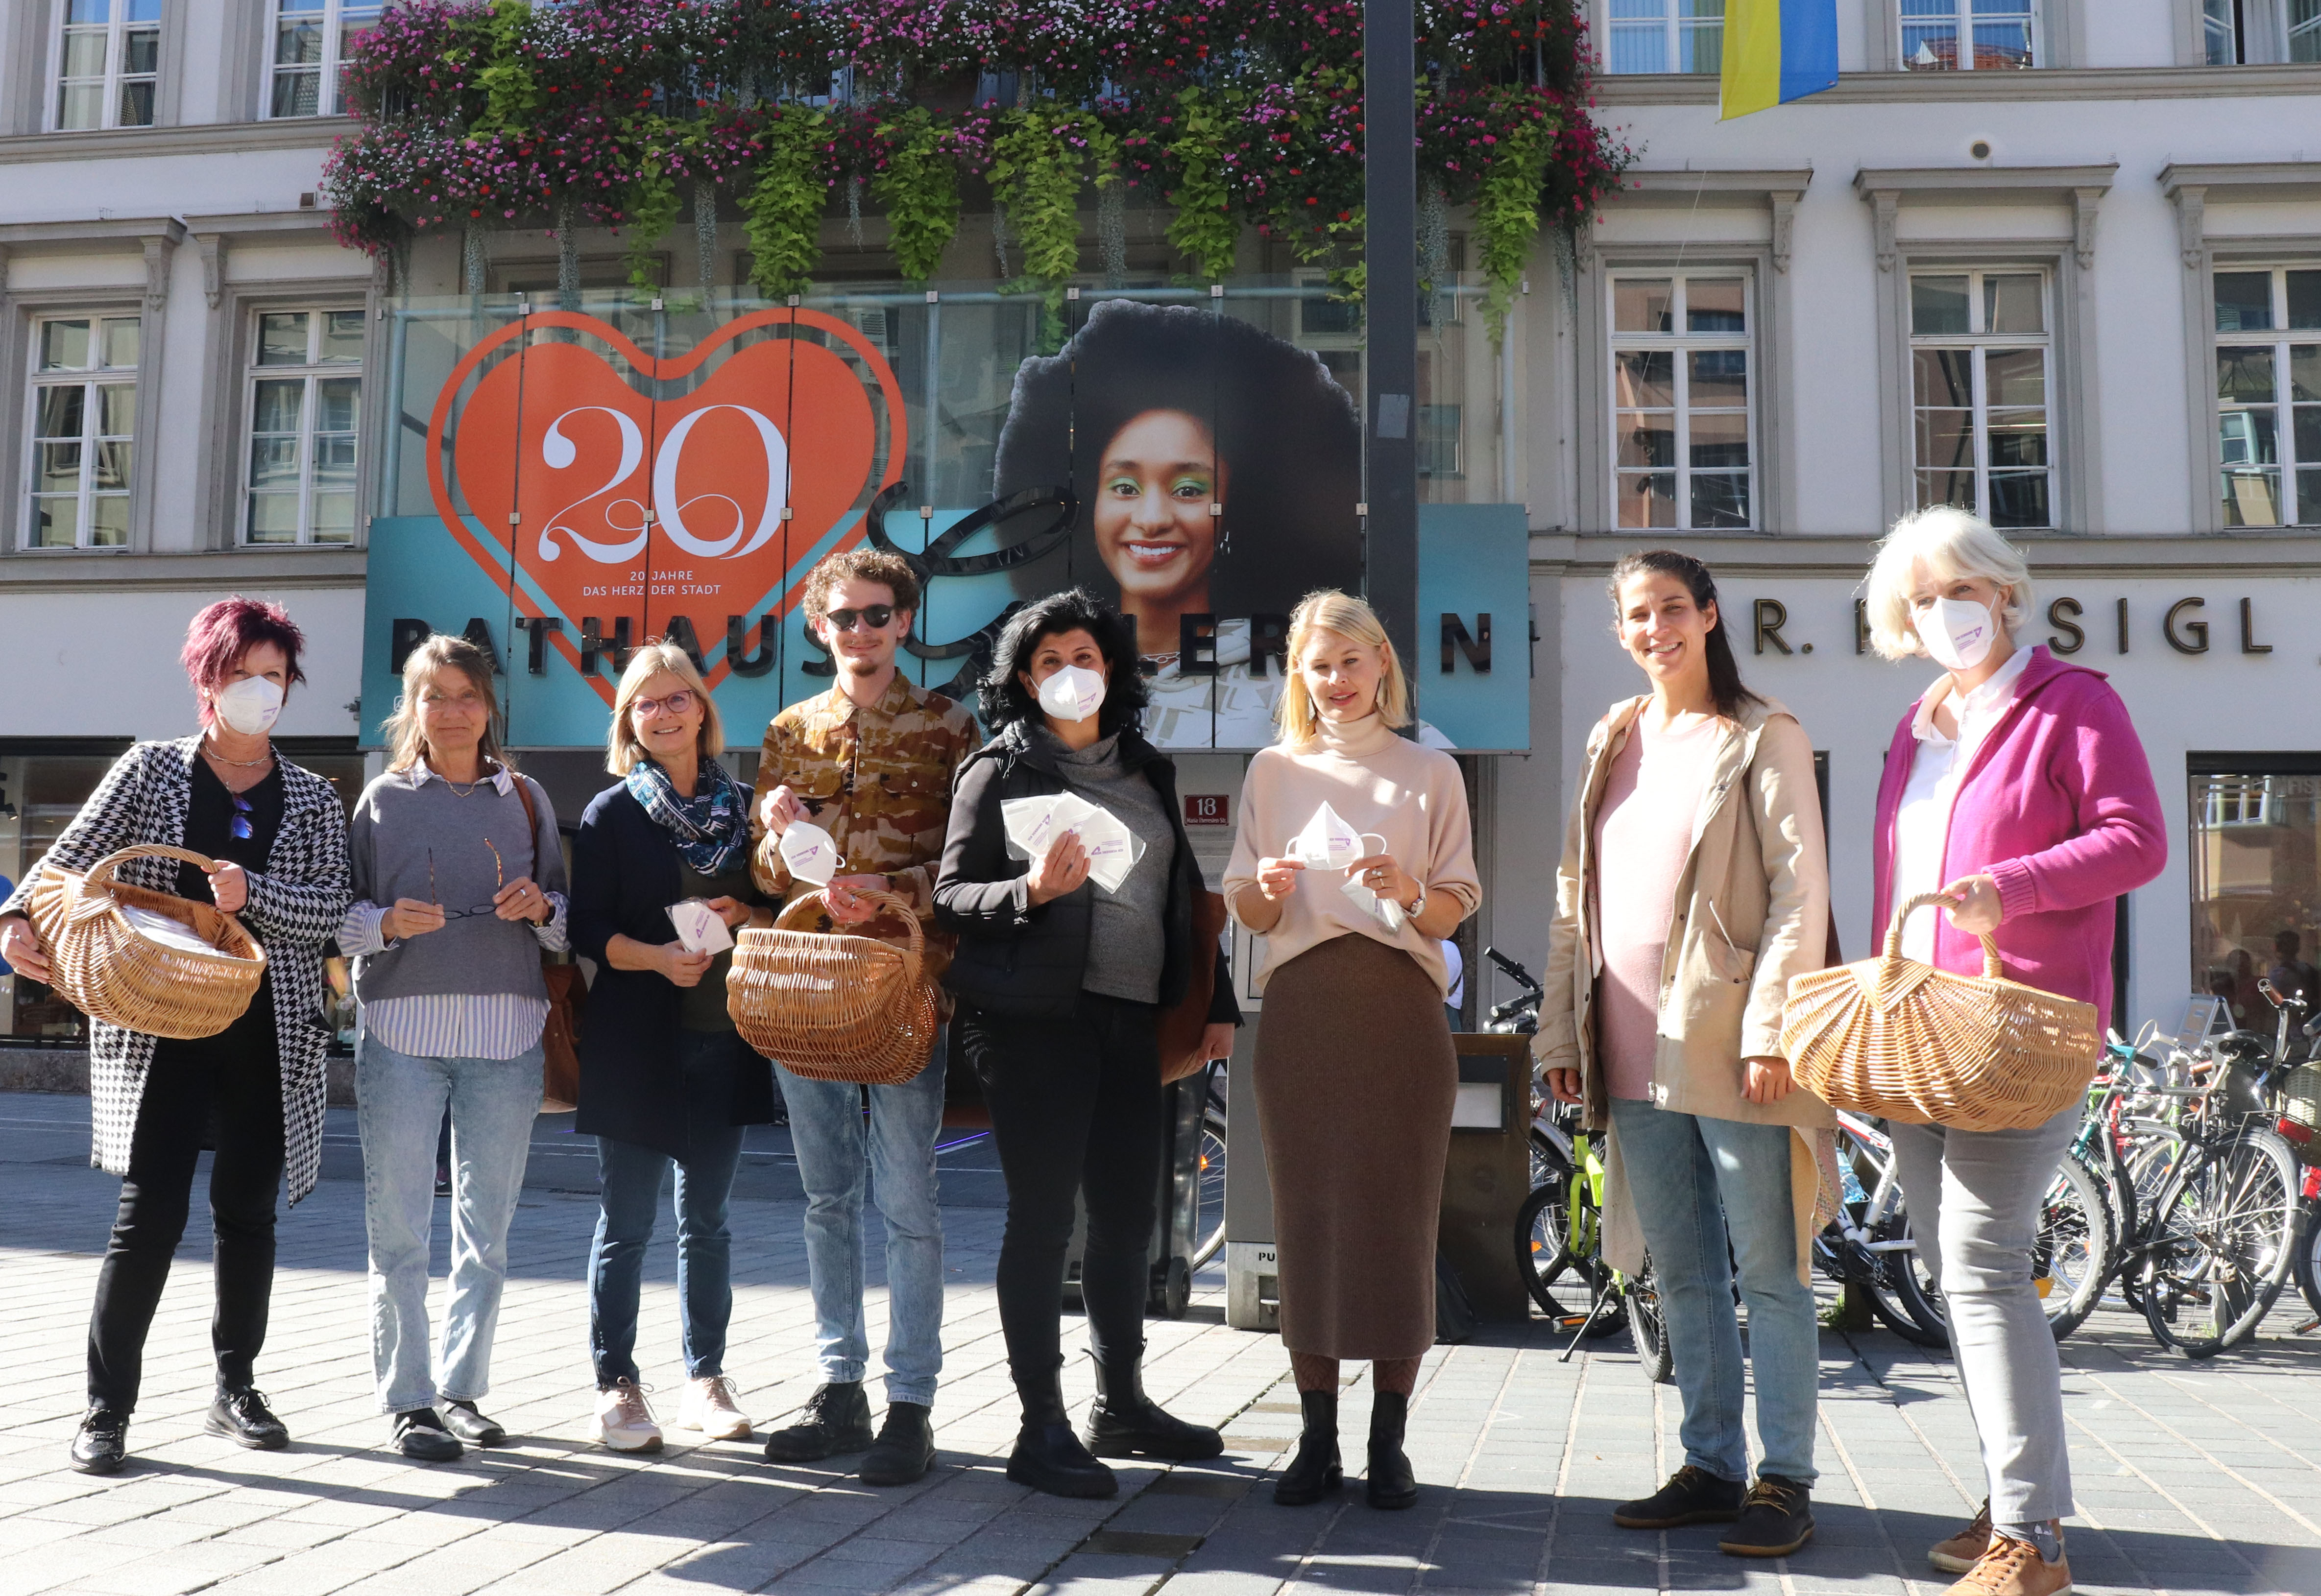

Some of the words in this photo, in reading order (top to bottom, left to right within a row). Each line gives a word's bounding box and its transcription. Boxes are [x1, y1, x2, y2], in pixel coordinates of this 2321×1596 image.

[538, 405, 791, 564] 20
[630, 571, 645, 581] 20
[651, 571, 694, 580] JAHRE
[583, 586, 607, 596] DAS
[612, 586, 645, 596] HERZ
[651, 585, 676, 595] DER
[681, 585, 721, 595] STADT
[1753, 598, 1814, 655] R.
[1197, 798, 1217, 816] 18
